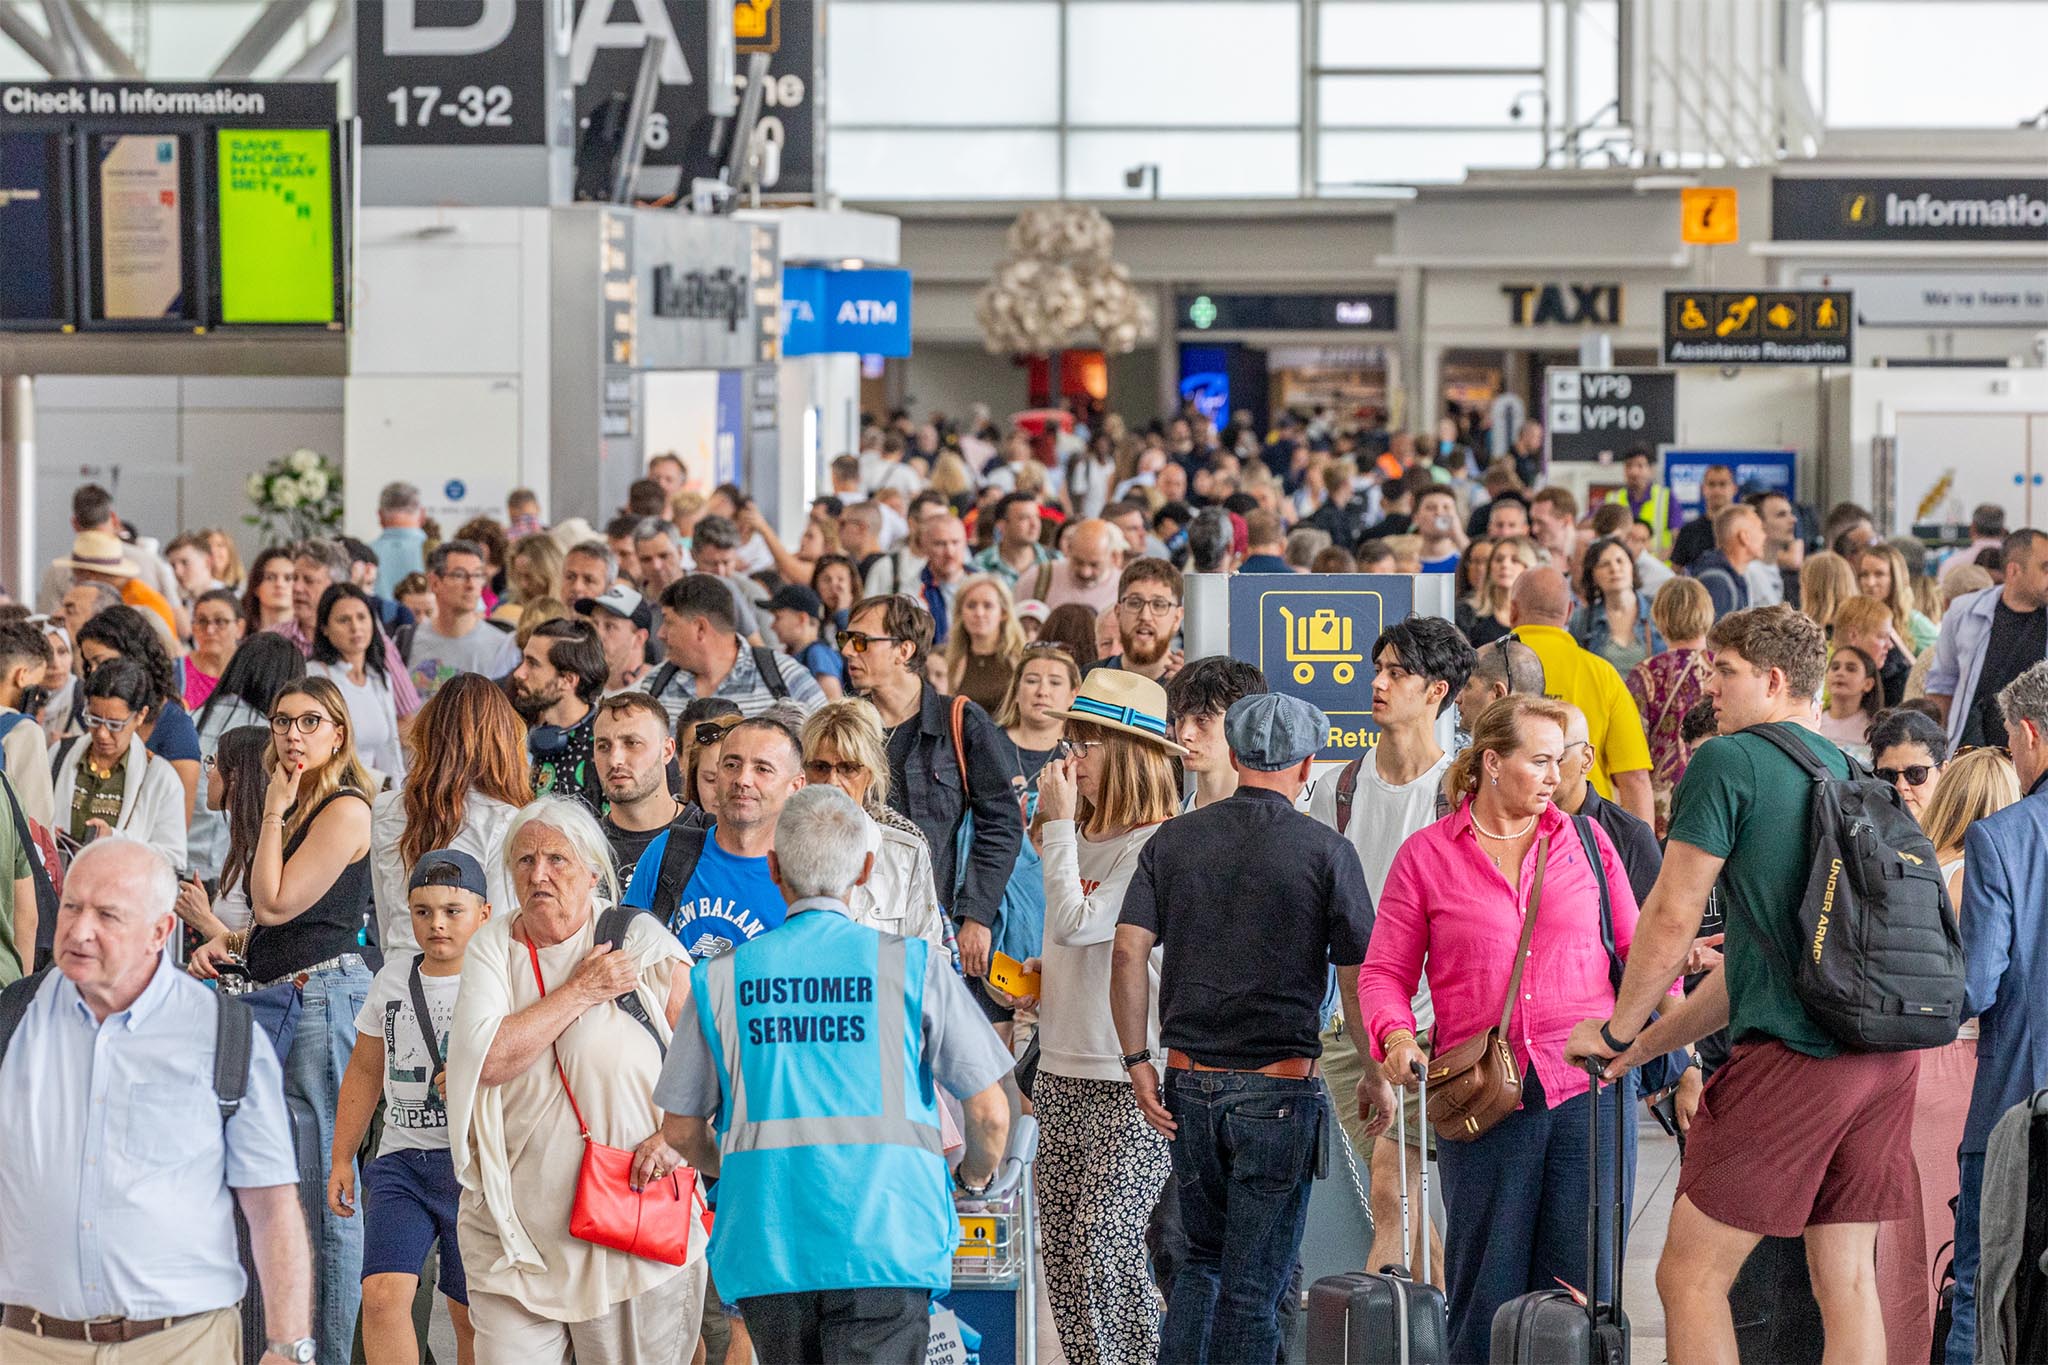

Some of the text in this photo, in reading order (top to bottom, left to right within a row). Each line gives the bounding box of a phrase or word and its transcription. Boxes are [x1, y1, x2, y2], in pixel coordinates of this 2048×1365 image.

[3, 87, 265, 115] Check In Information
[386, 84, 513, 127] 17-32
[231, 141, 281, 151] SAVE
[1502, 283, 1625, 326] TAXI
[2024, 289, 2044, 305] to
[837, 299, 897, 325] ATM
[1671, 341, 1847, 362] Assistance Reception
[1582, 374, 1632, 399] VP9
[1582, 405, 1645, 430] VP10
[1822, 858, 1843, 912] UNDER
[739, 976, 873, 1006] CUSTOMER
[385, 1008, 396, 1048] ANGELES
[750, 1015, 865, 1045] SERVICES
[927, 1340, 956, 1356] extra
